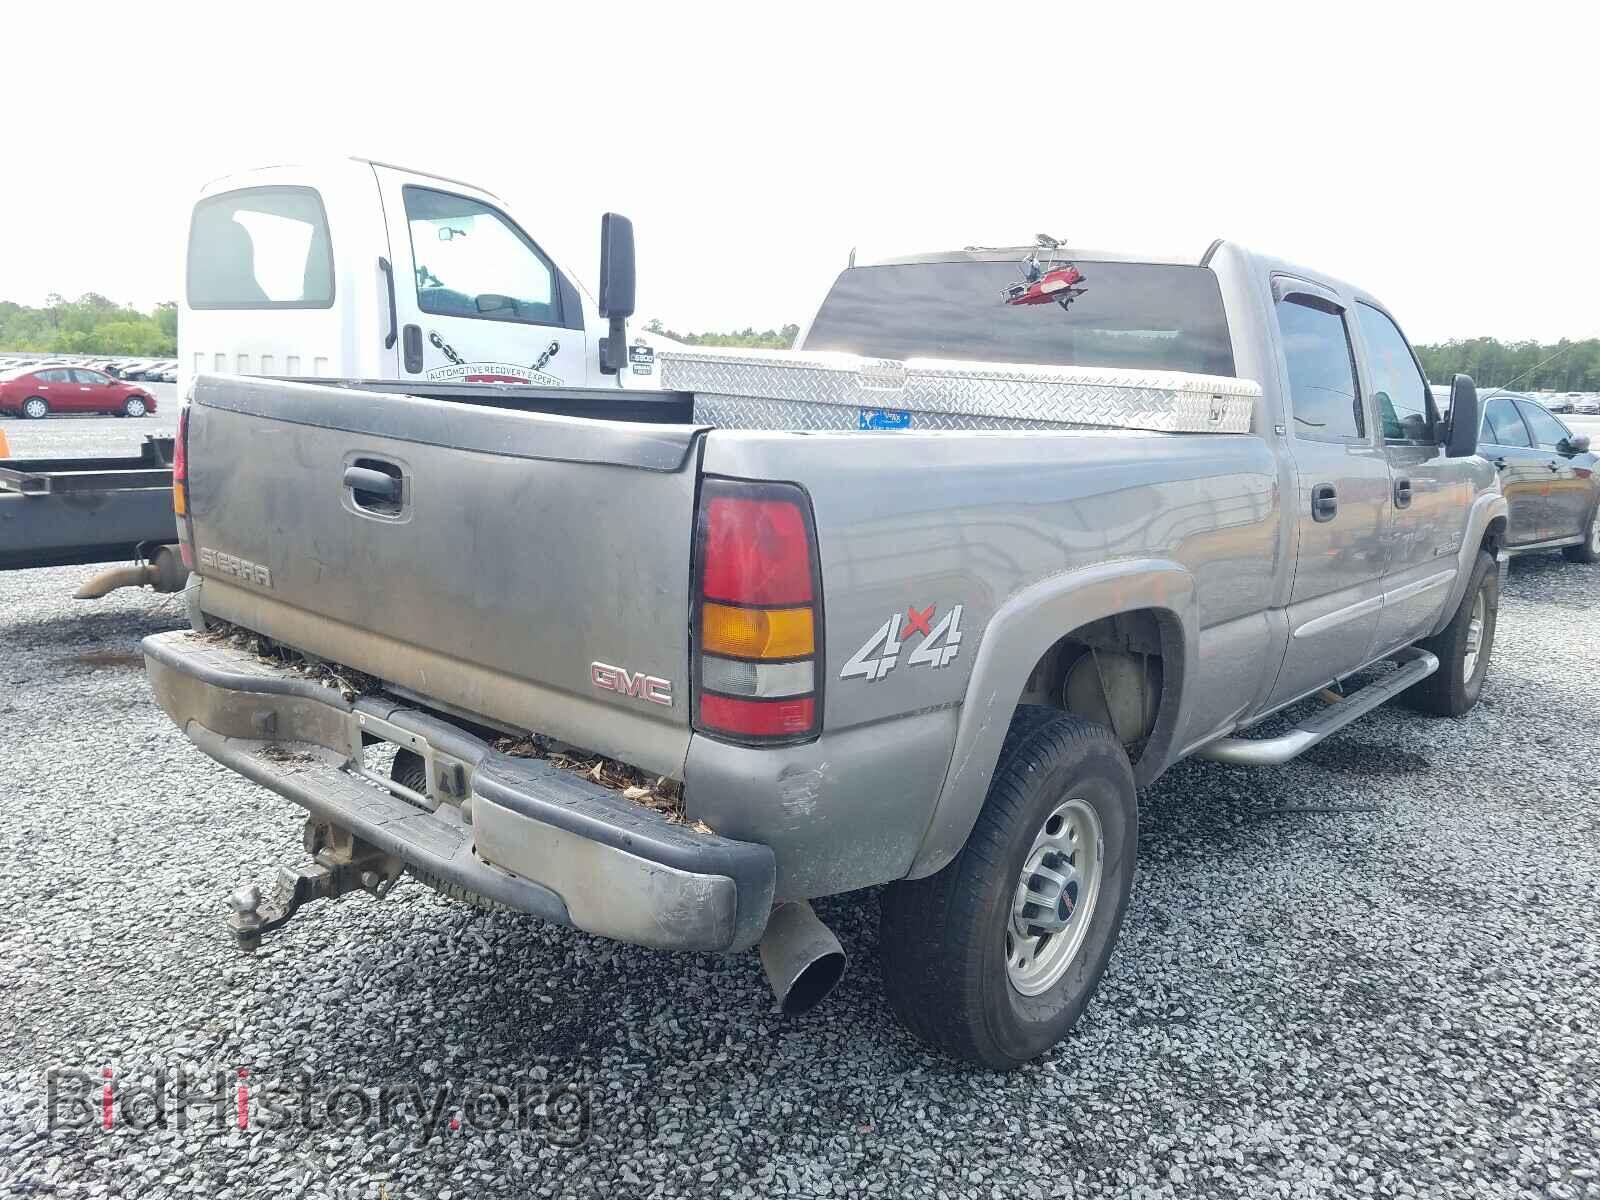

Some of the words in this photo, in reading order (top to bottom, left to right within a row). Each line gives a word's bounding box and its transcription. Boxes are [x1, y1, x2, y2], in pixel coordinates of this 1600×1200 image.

[430, 366, 482, 380] AUTOMOTIVE
[485, 366, 526, 378] RECOVERY
[200, 547, 273, 588] SIERRA
[591, 661, 672, 707] GMC
